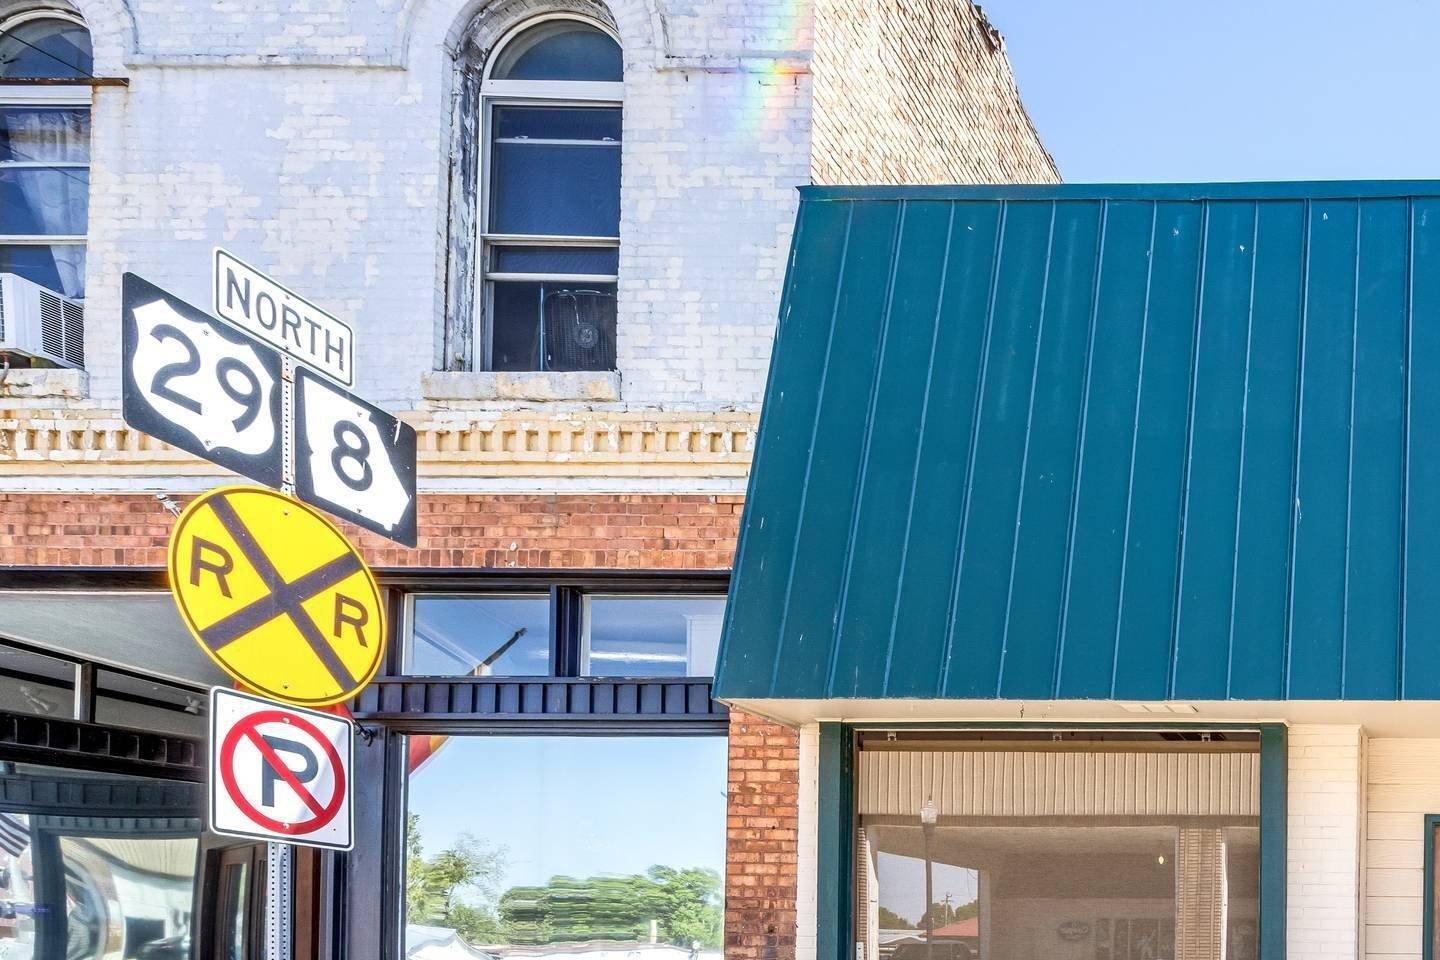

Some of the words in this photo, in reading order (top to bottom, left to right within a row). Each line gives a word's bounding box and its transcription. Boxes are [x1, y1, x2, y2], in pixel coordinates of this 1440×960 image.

[226, 266, 345, 372] NORTH
[150, 323, 262, 433] 29
[331, 419, 373, 492] 8
[189, 535, 235, 600] R
[333, 592, 369, 648] R
[261, 733, 319, 808] P
